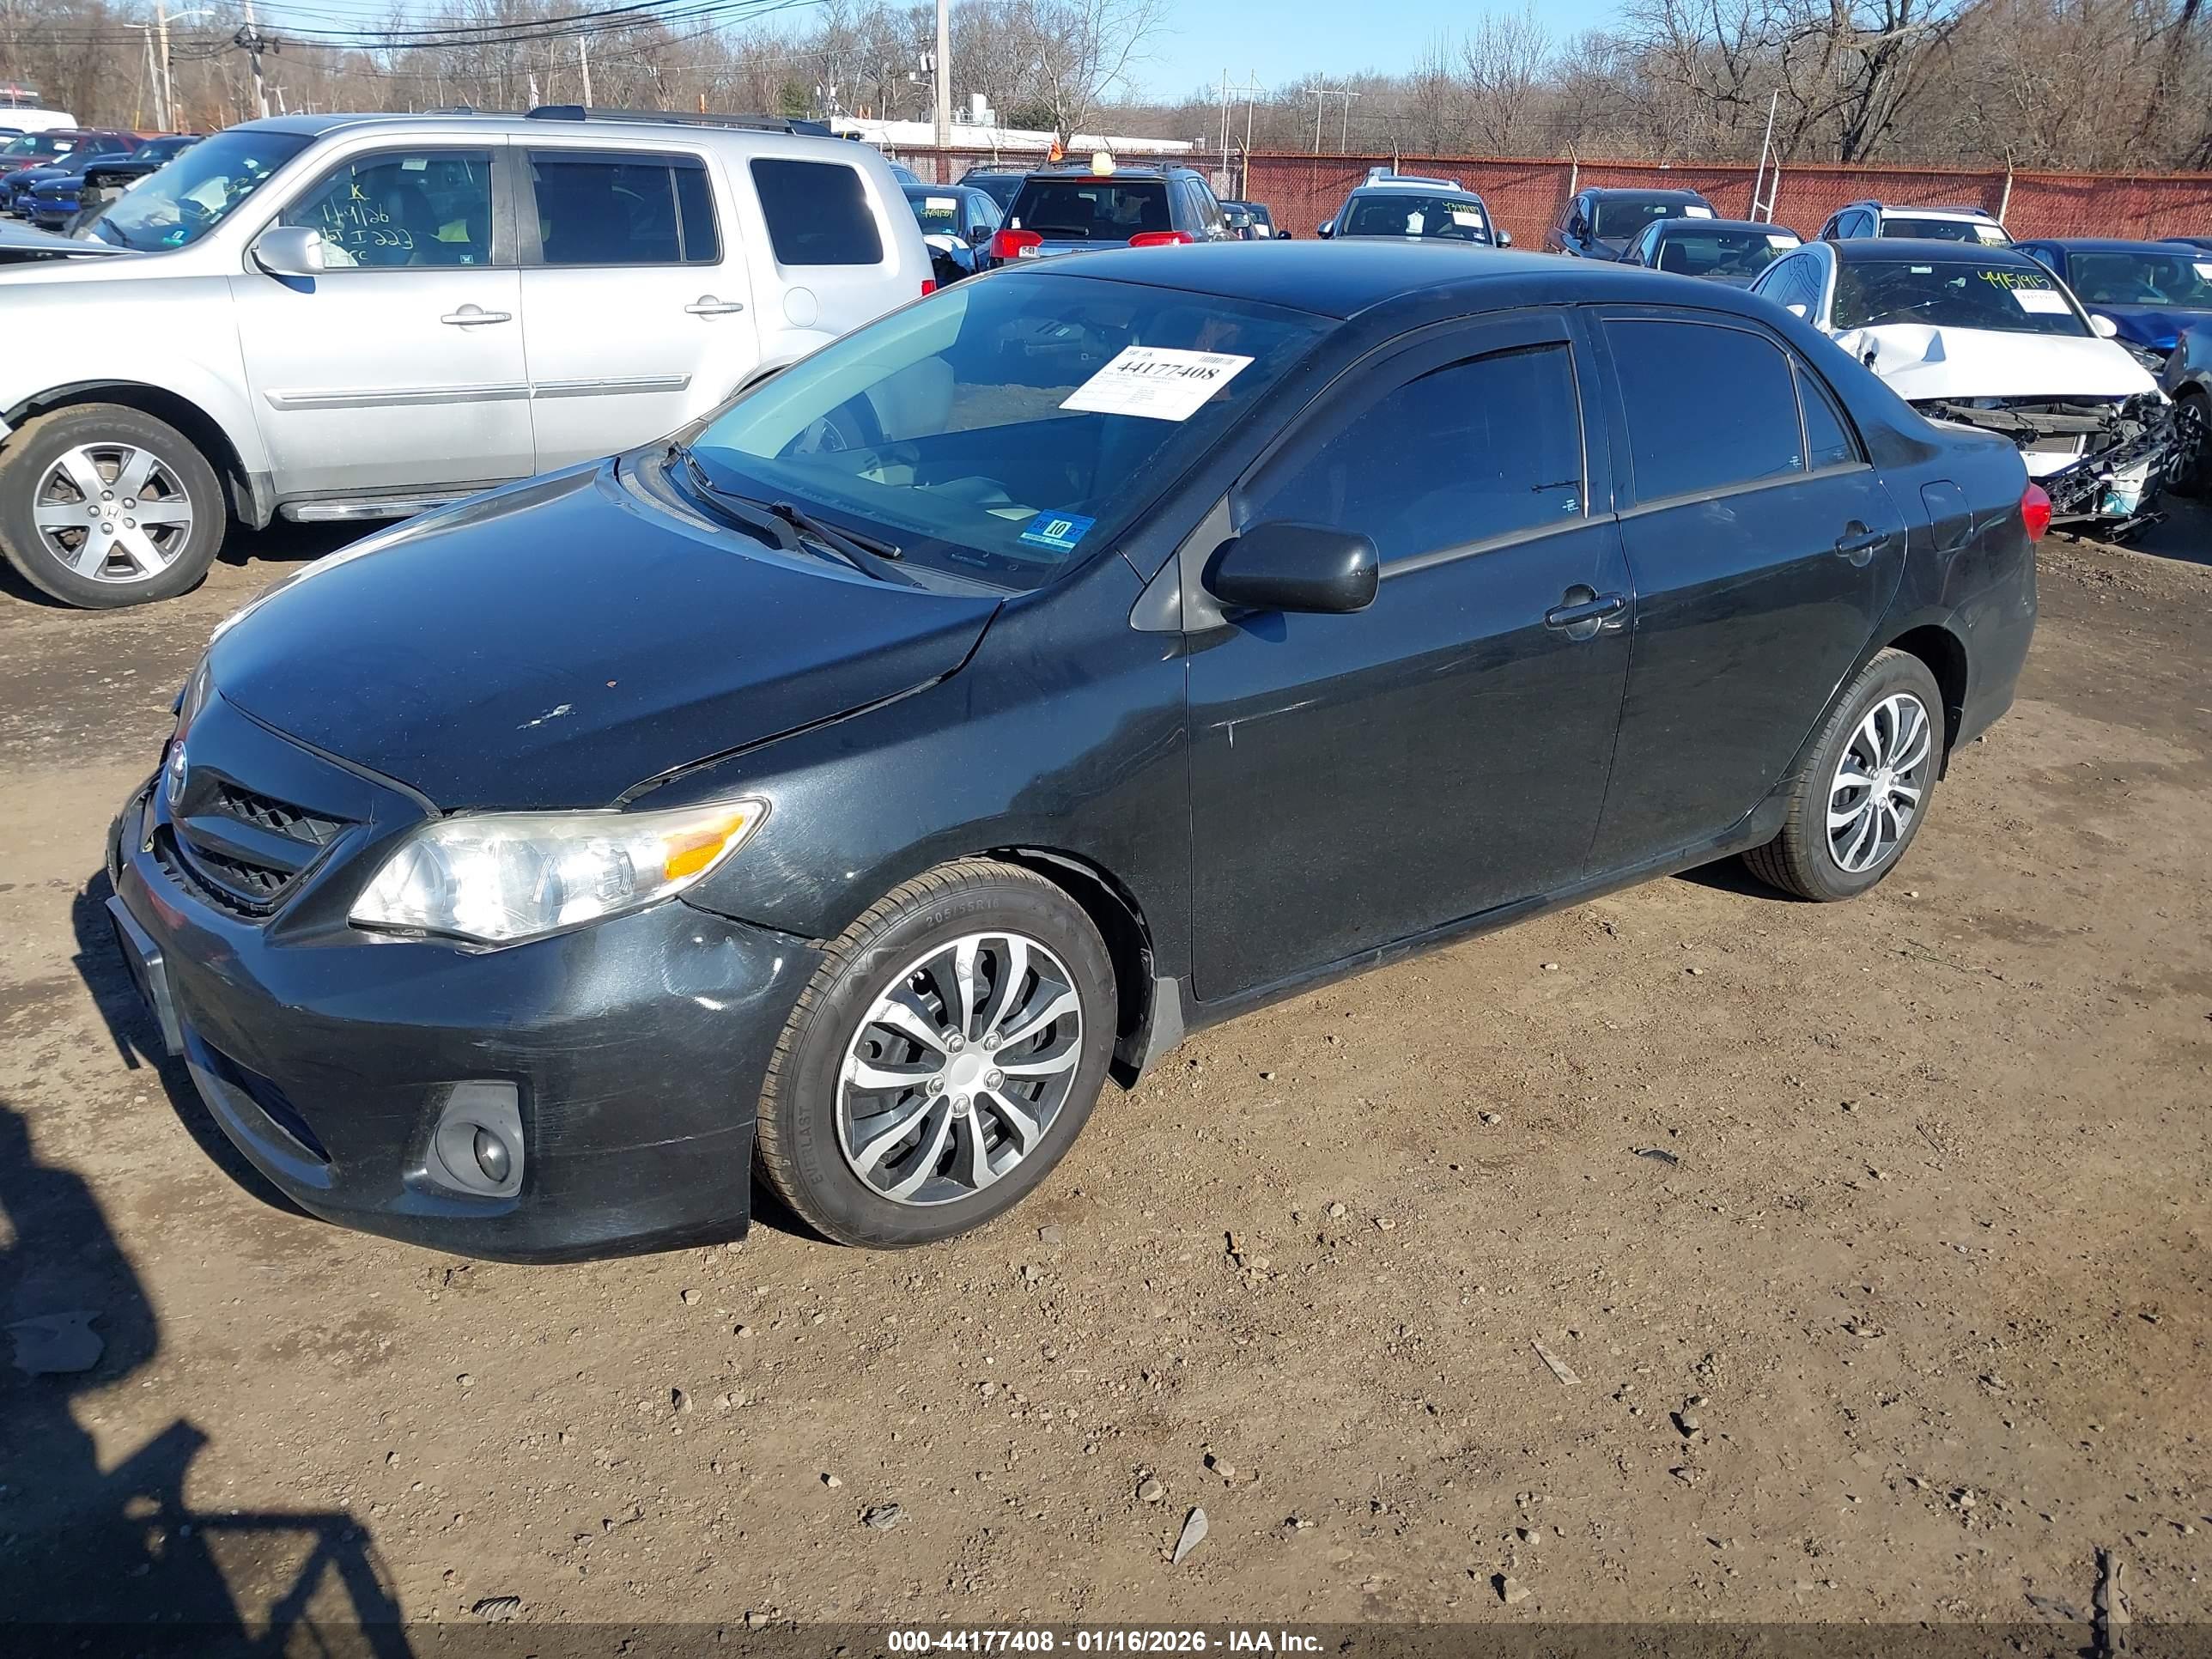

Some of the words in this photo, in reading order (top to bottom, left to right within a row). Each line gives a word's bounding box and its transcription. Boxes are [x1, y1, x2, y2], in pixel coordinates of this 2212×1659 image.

[1116, 361, 1220, 380] 44177408
[1048, 522, 1067, 535] 10
[798, 1105, 824, 1186] EVERLAST
